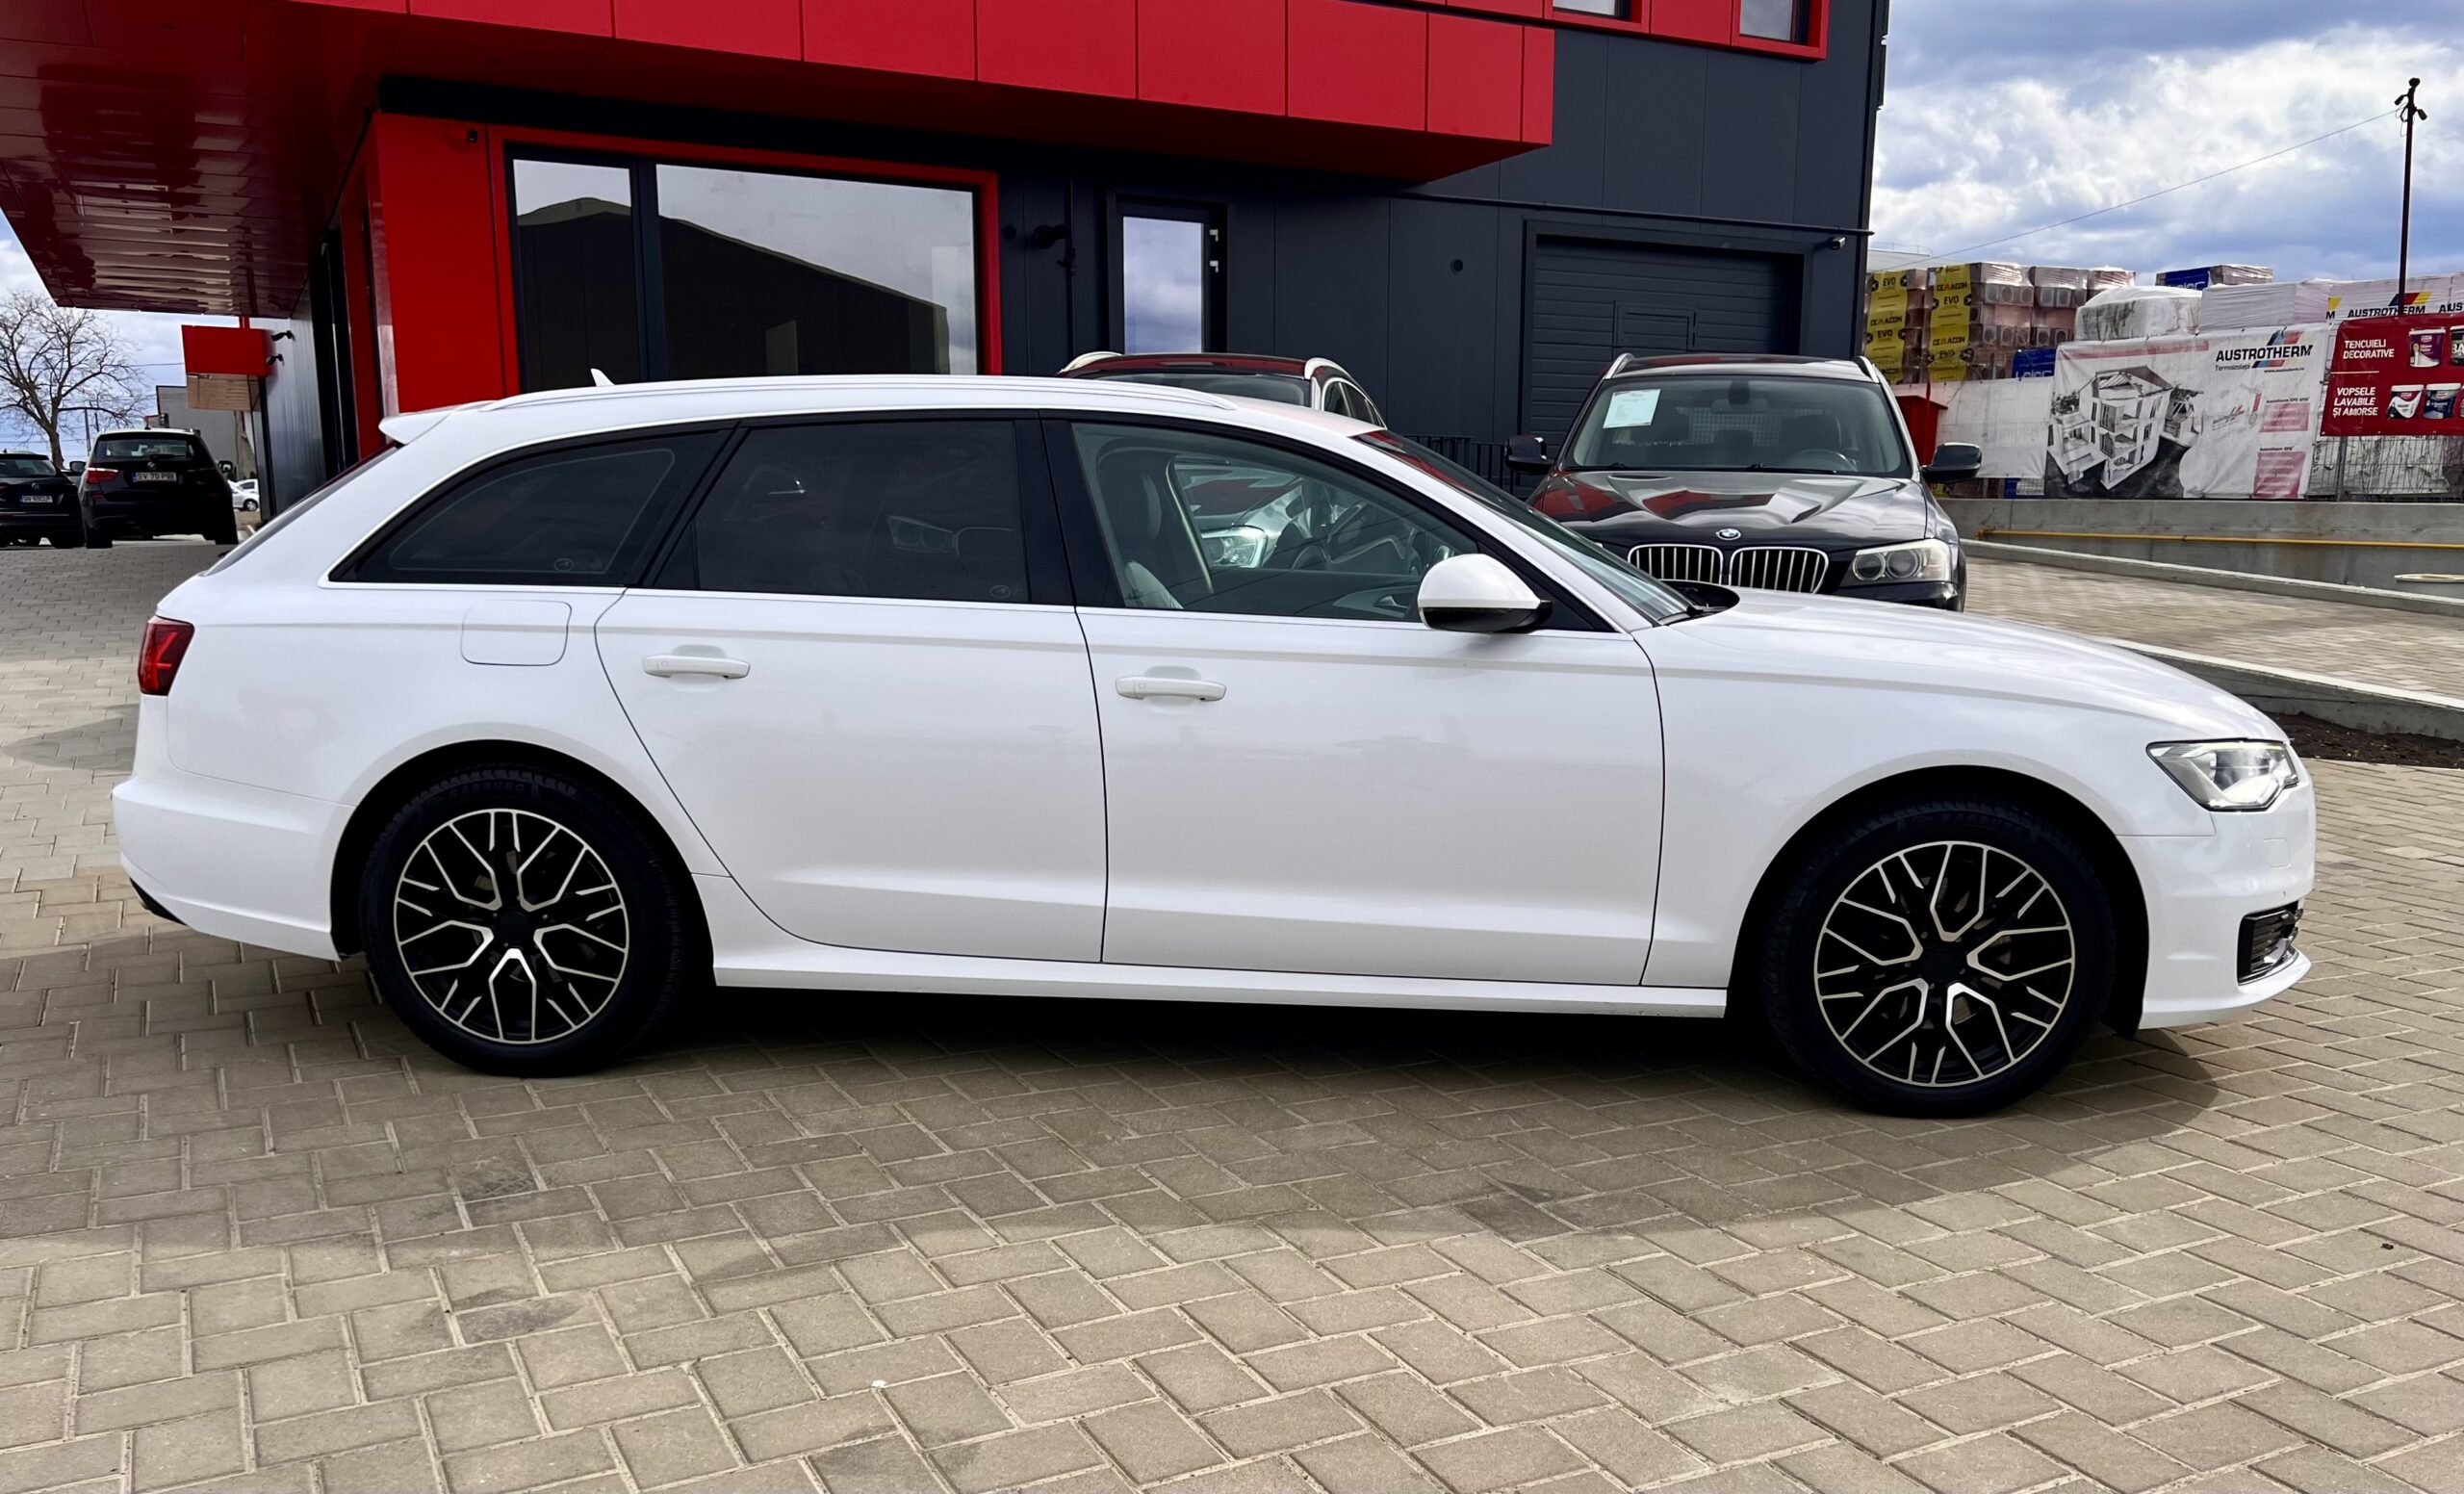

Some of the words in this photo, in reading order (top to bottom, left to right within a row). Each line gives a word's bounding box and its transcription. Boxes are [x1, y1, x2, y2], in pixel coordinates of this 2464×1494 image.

[1883, 276, 1896, 287] EVO
[1943, 295, 1960, 305] EVO
[1877, 329, 1893, 339] EVO
[2344, 339, 2387, 349] TENCUIELI
[2216, 345, 2314, 362] AUSTROTHERM
[2342, 348, 2395, 360] DECORATIVE
[2336, 387, 2376, 397] VOPSELE
[2333, 398, 2376, 406] LAVABILE
[2342, 407, 2378, 416] AMORSE
